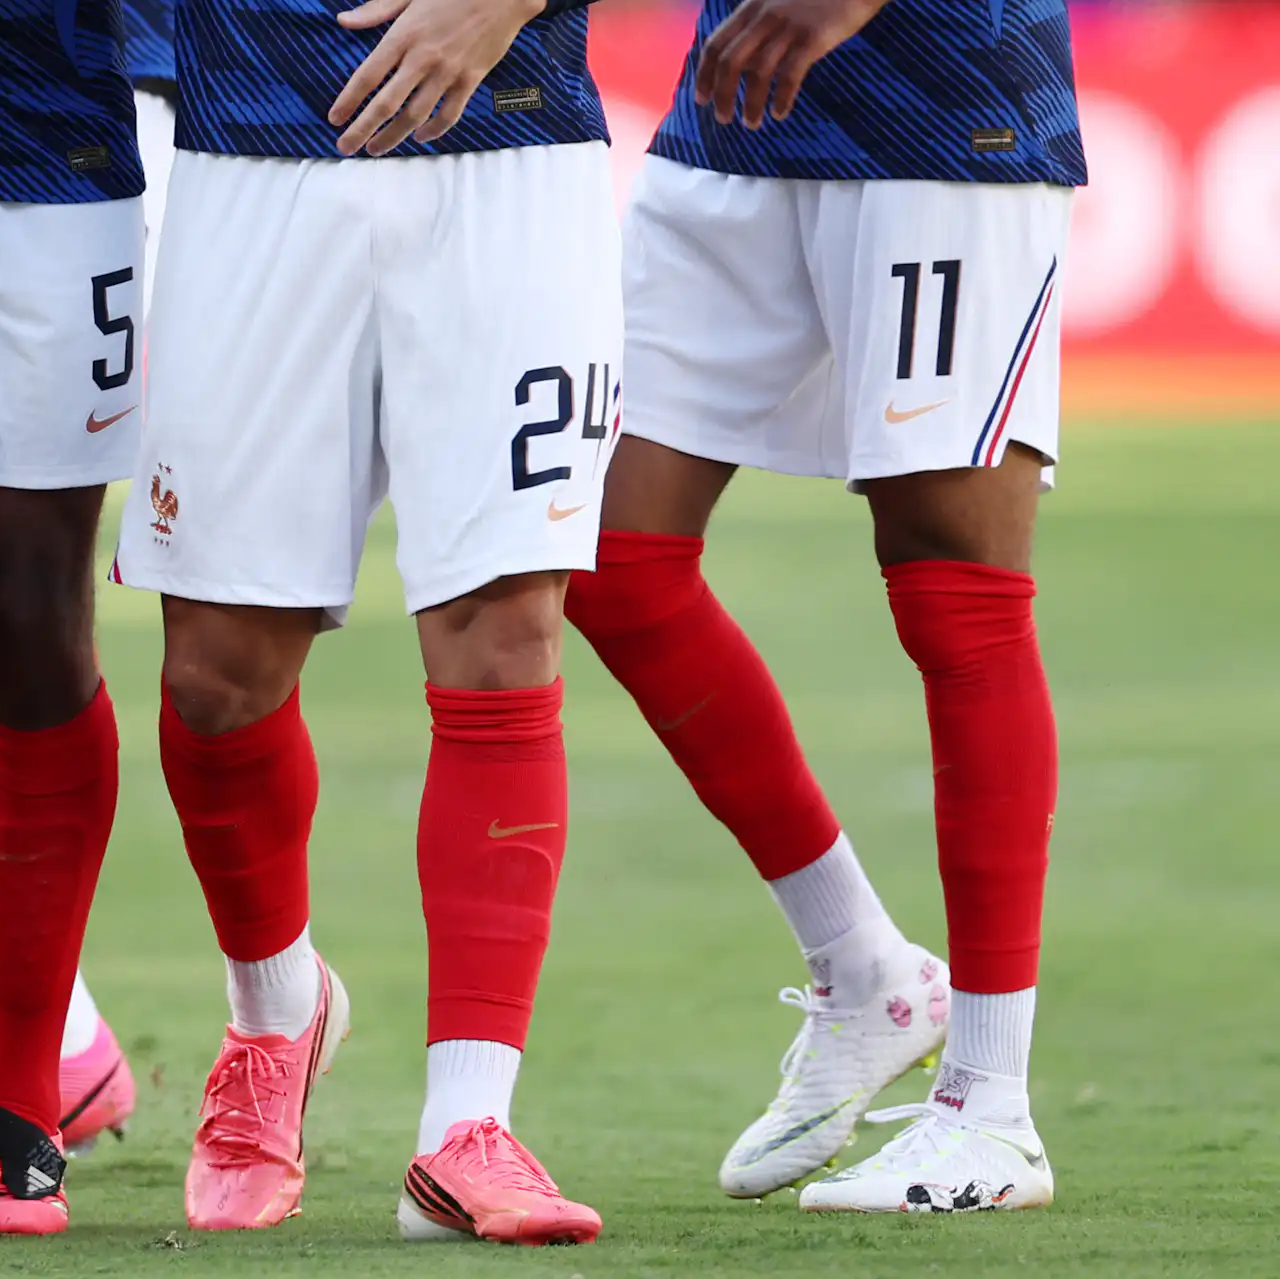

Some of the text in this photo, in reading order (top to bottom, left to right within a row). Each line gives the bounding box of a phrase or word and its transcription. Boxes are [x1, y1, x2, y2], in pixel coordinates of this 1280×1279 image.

[91, 266, 134, 391] 5
[891, 259, 961, 380] 11
[511, 362, 609, 491] 24
